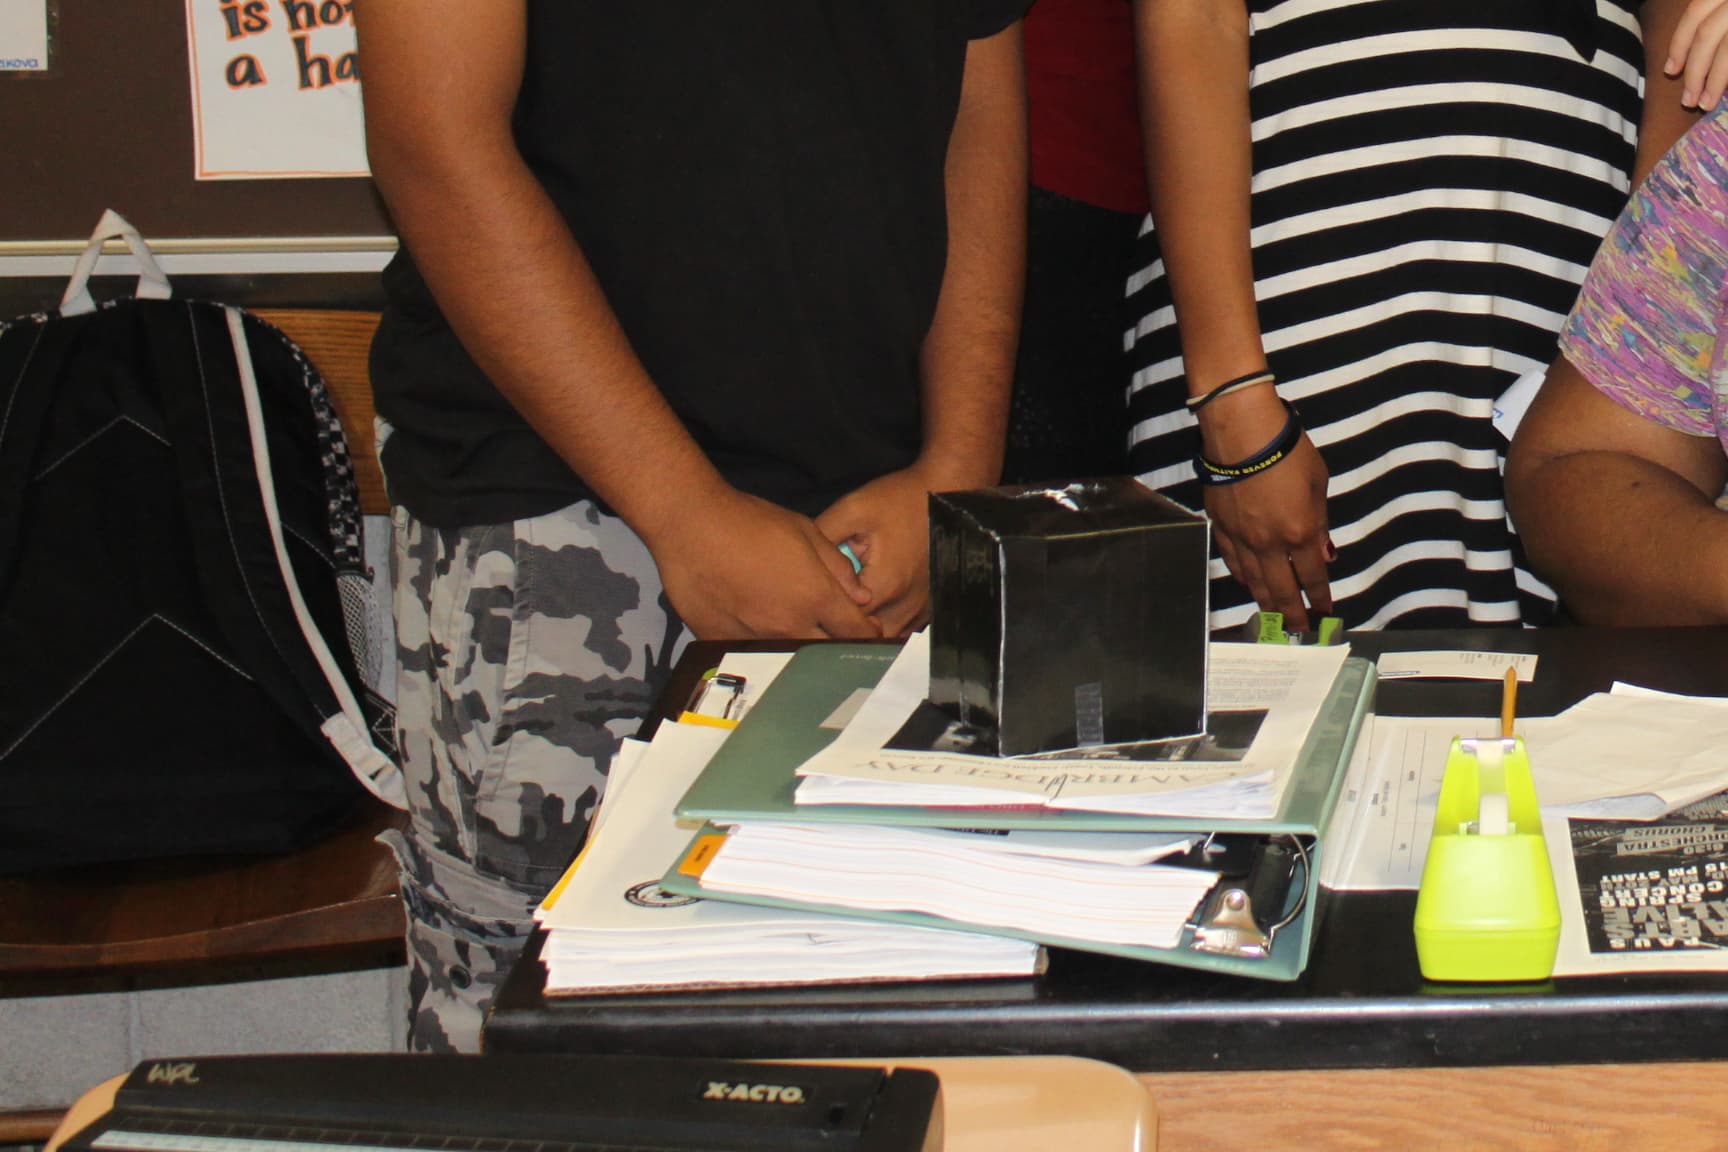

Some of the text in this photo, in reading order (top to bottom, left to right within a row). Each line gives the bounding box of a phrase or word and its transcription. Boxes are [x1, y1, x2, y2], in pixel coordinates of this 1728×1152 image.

[225, 49, 267, 91] a
[1667, 865, 1699, 878] PM
[1599, 891, 1703, 908] SPRING
[703, 1081, 803, 1104] X-ACTO
